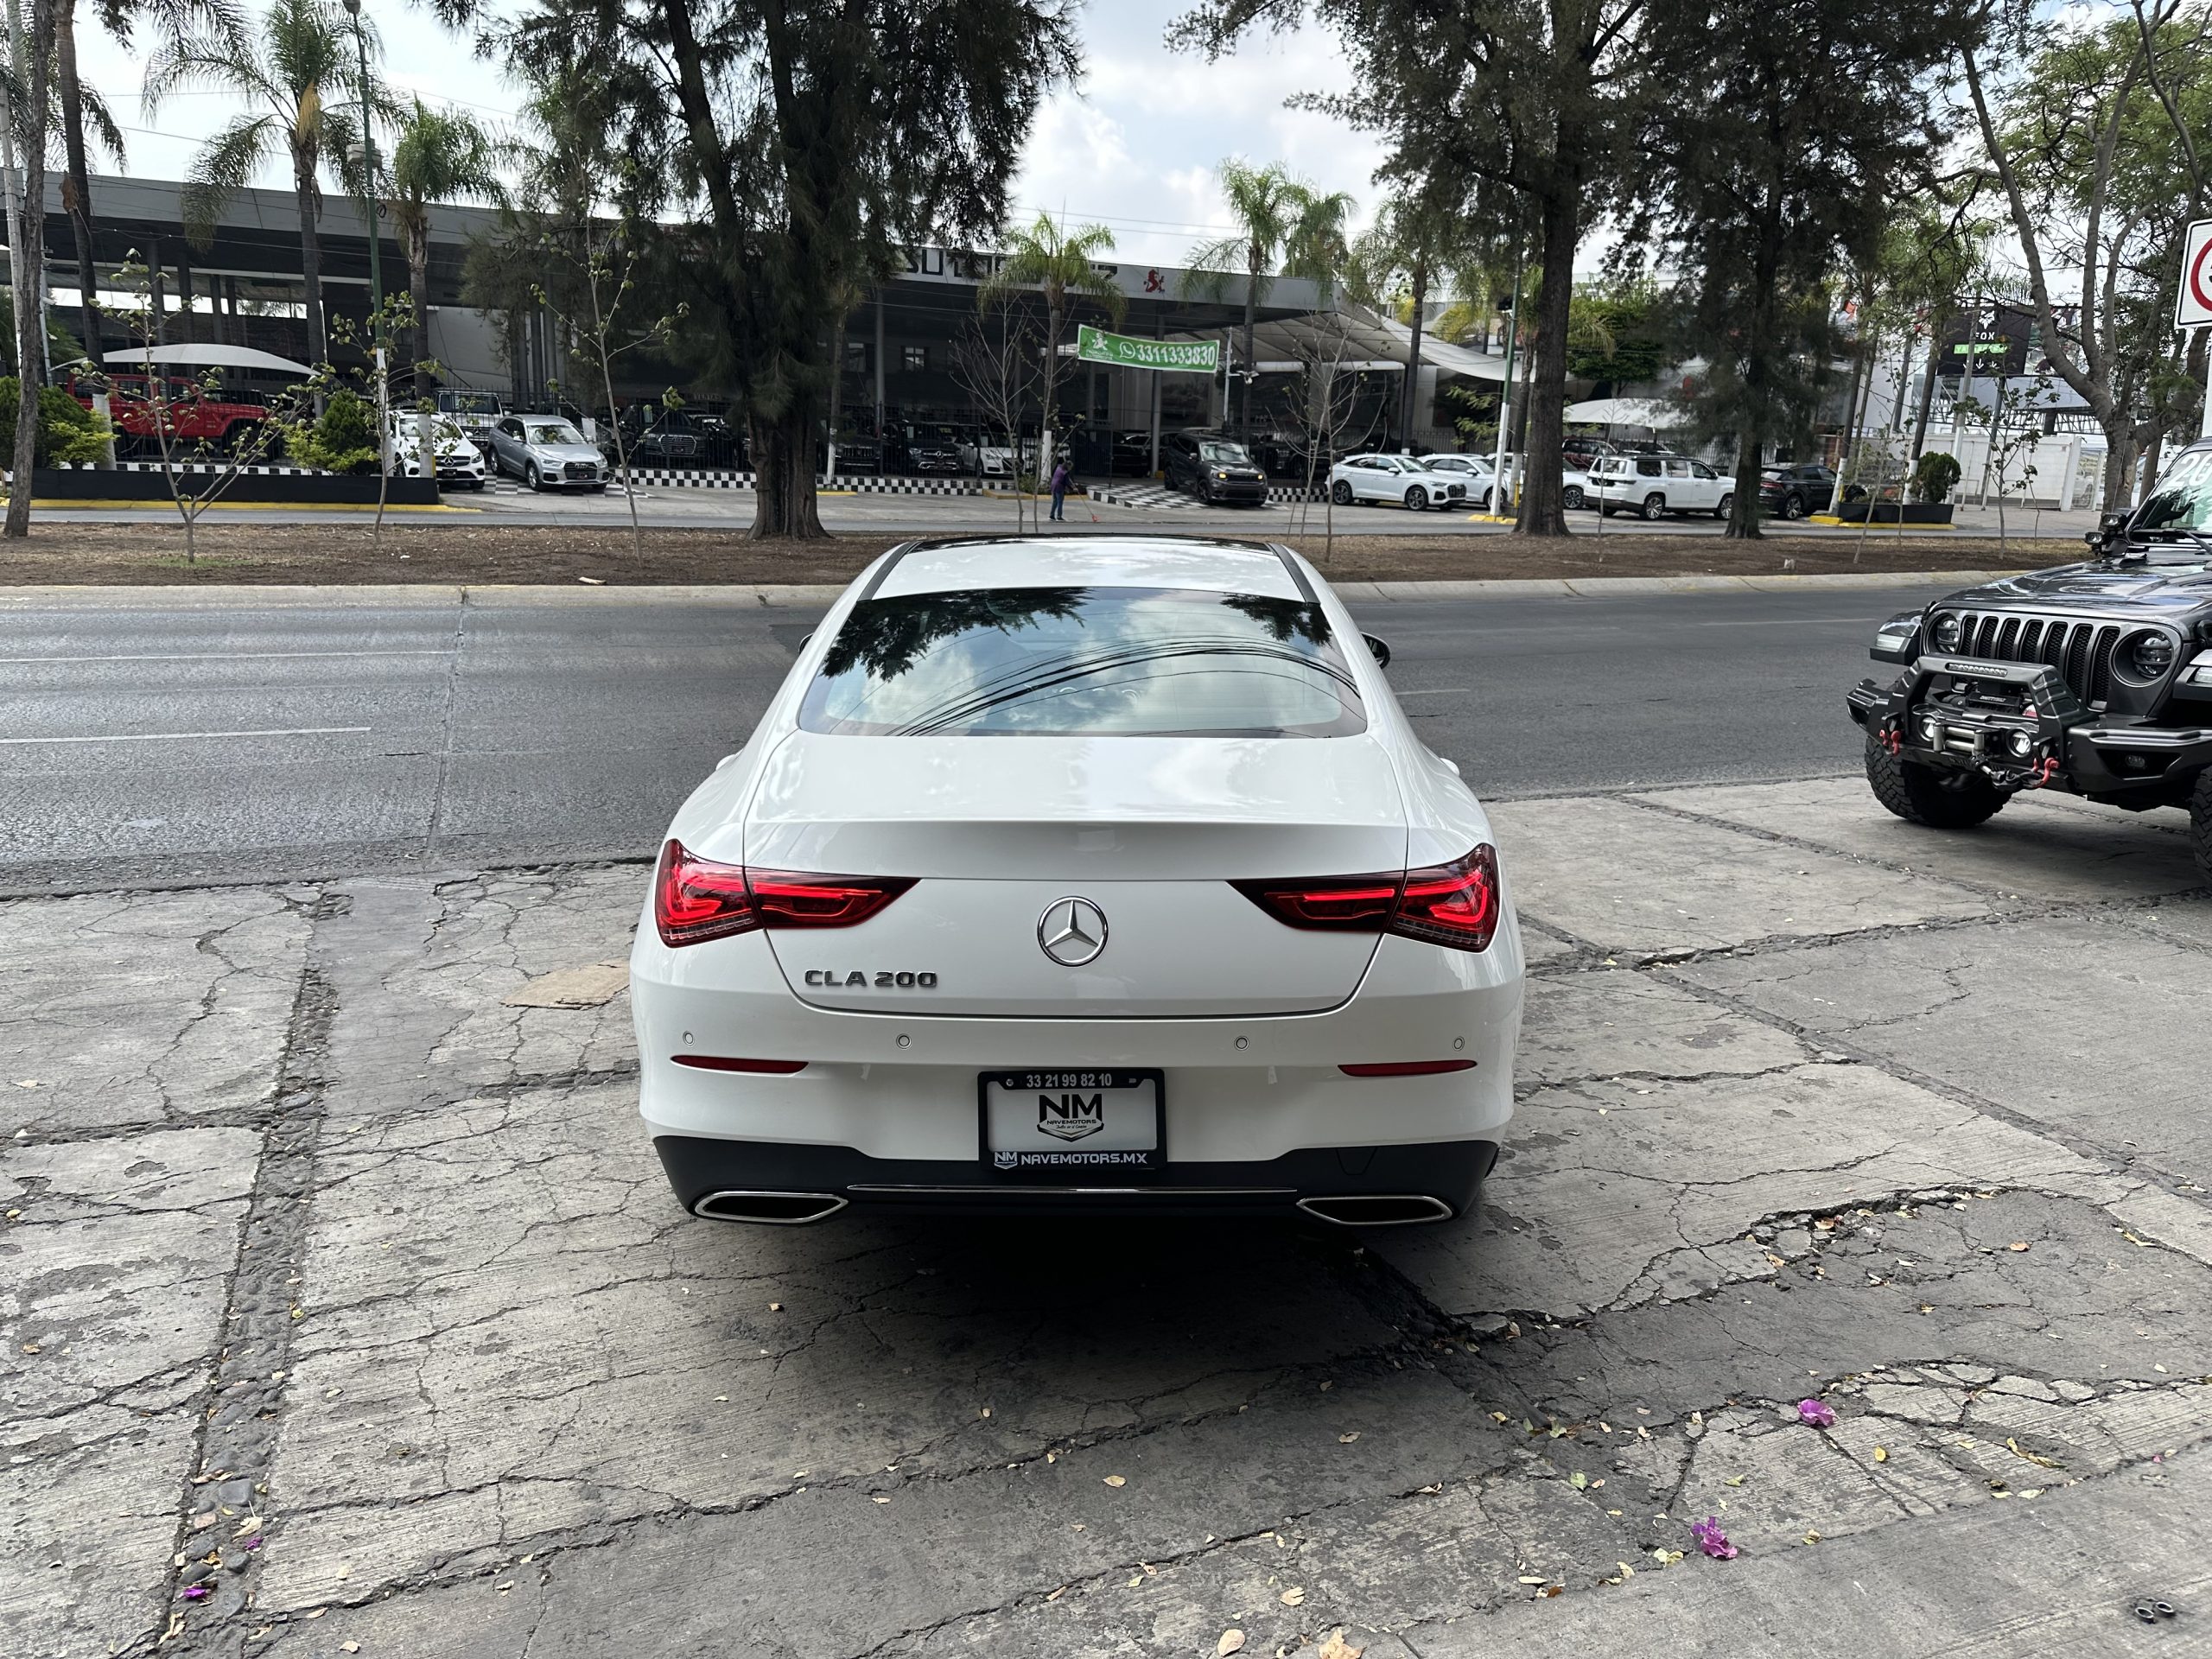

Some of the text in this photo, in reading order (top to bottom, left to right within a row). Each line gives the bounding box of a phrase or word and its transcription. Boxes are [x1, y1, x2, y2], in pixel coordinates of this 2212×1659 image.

[1136, 344, 1215, 366] 3311333830
[804, 969, 938, 988] CLA 200
[1027, 1073, 1112, 1088] 33 21 99 82 10
[1039, 1094, 1103, 1123] NM
[995, 1151, 1147, 1166] NM NAVEMOTORS.MX
